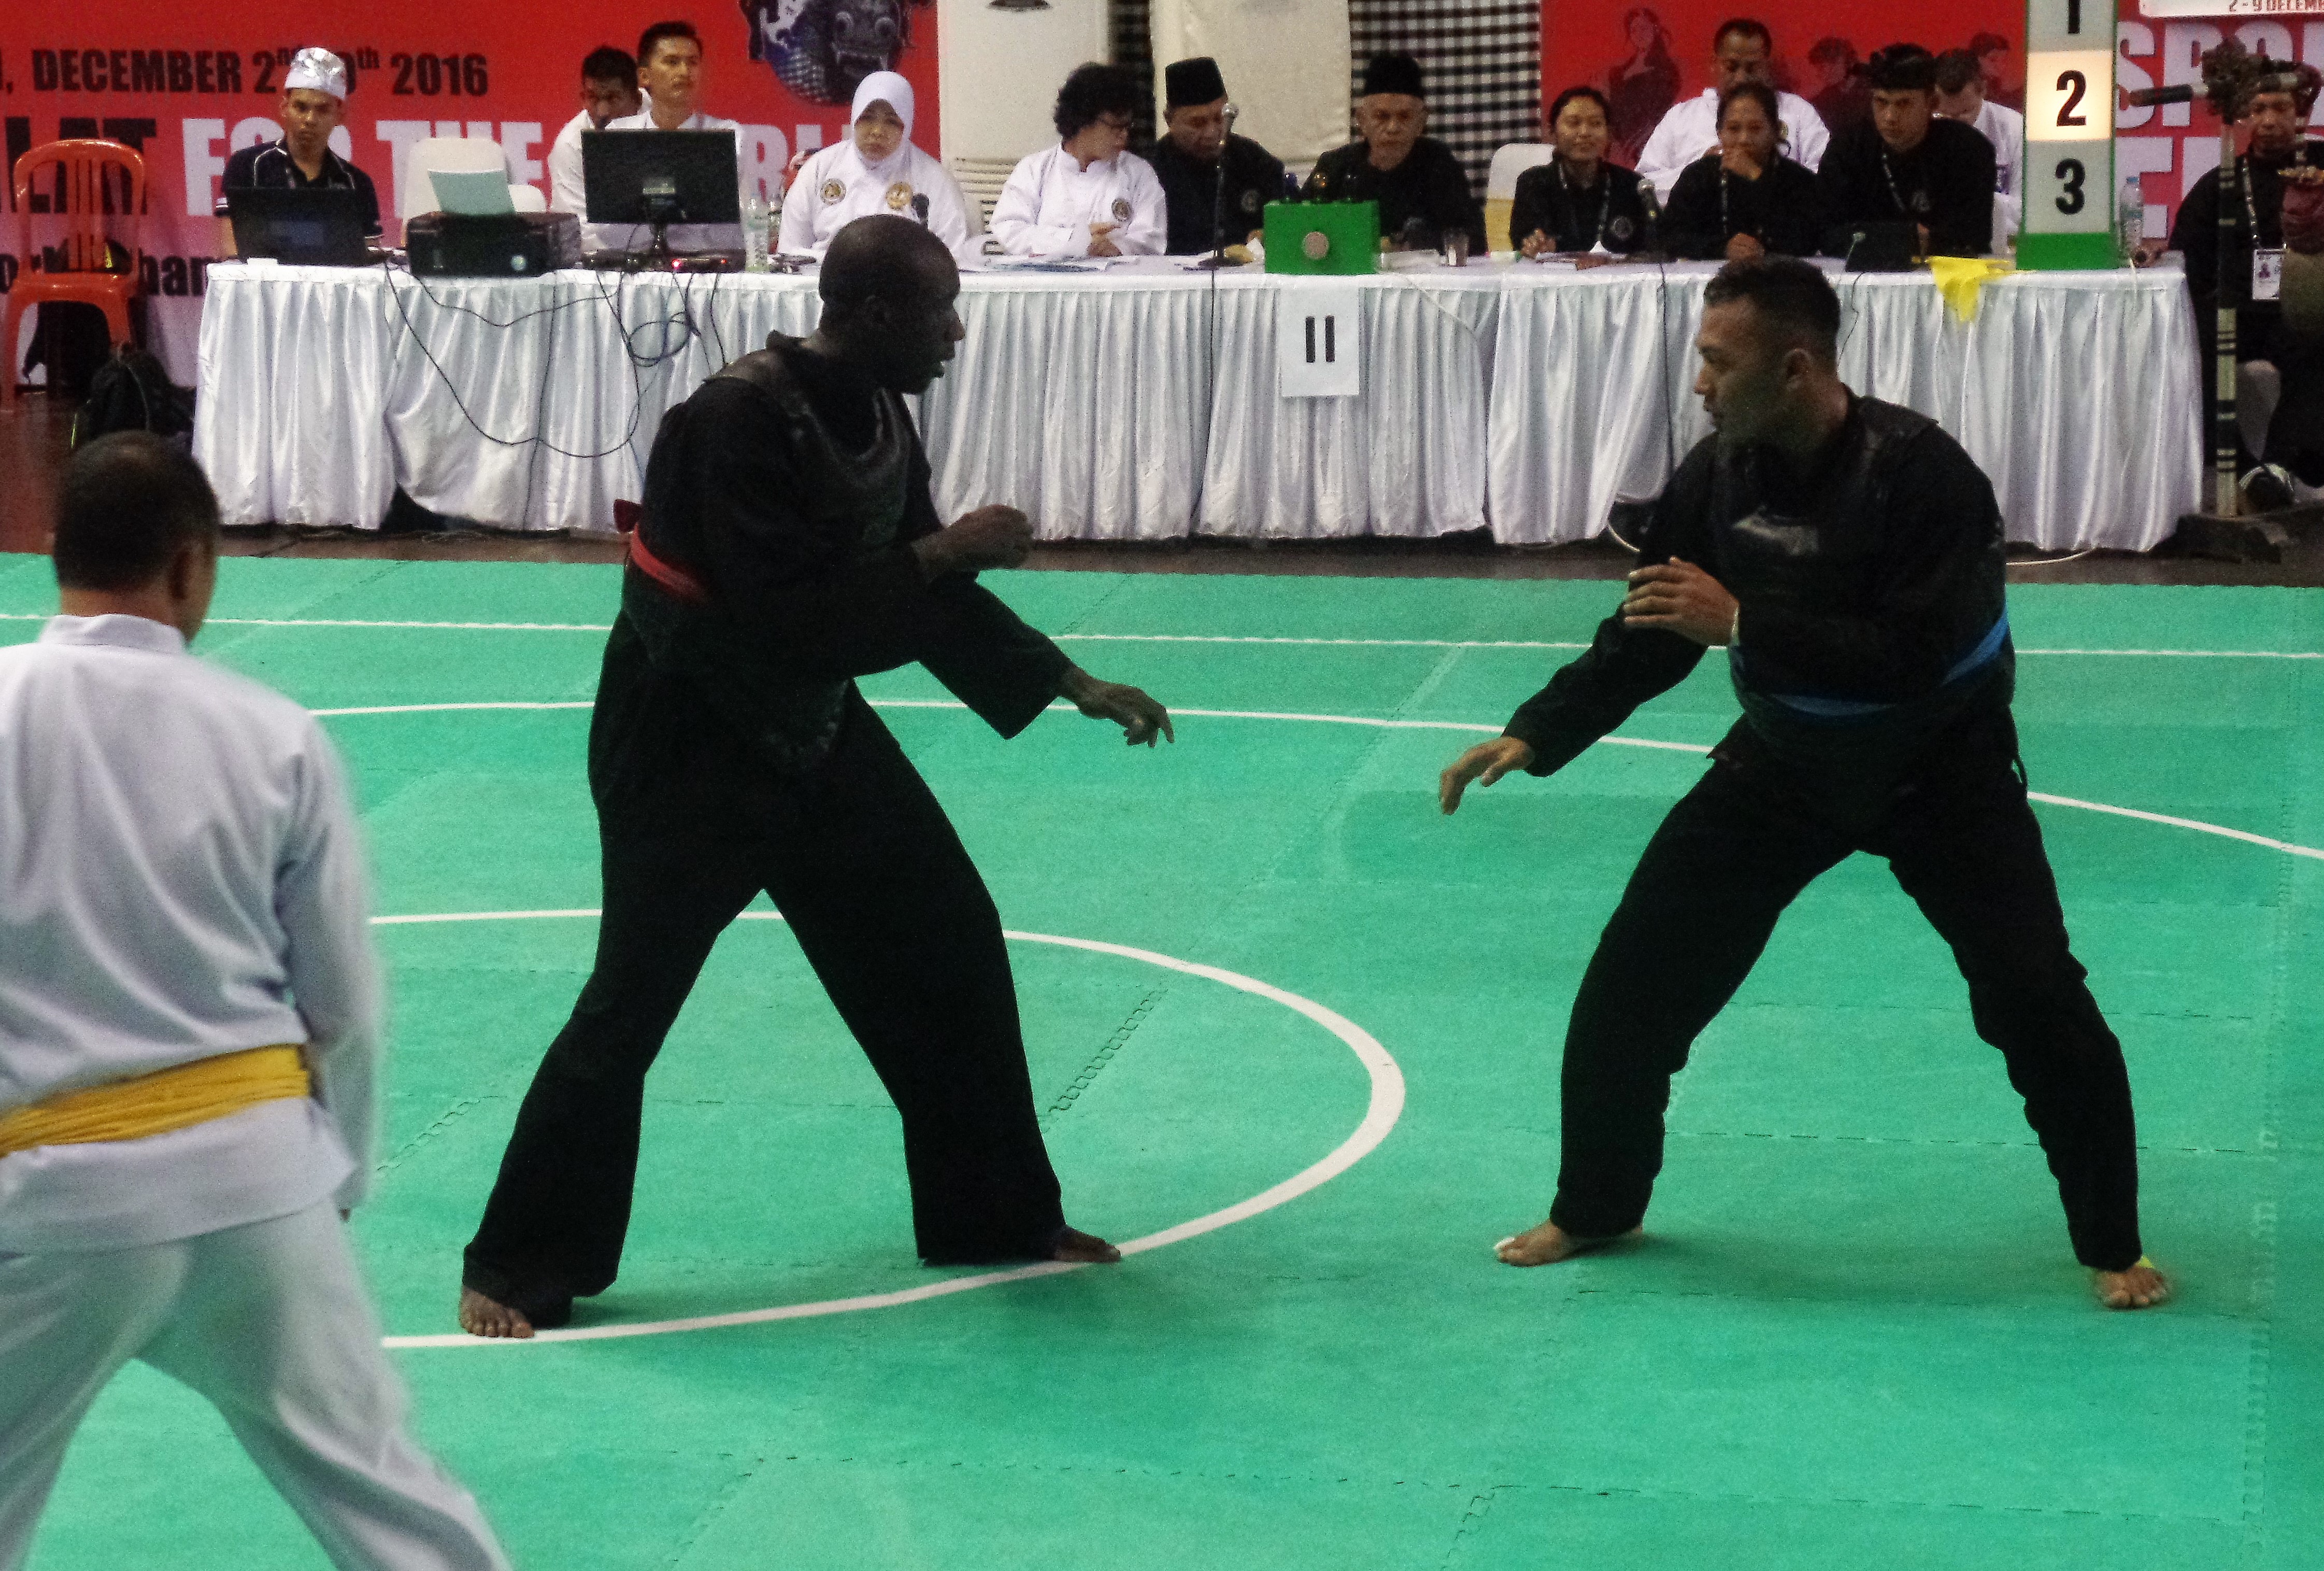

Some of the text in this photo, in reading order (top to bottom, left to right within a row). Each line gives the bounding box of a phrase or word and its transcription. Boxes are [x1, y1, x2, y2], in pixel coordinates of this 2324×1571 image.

[33, 49, 241, 93] DECEMBER
[391, 53, 488, 96] 2016
[2056, 69, 2087, 126] 2
[2055, 158, 2086, 215] 3
